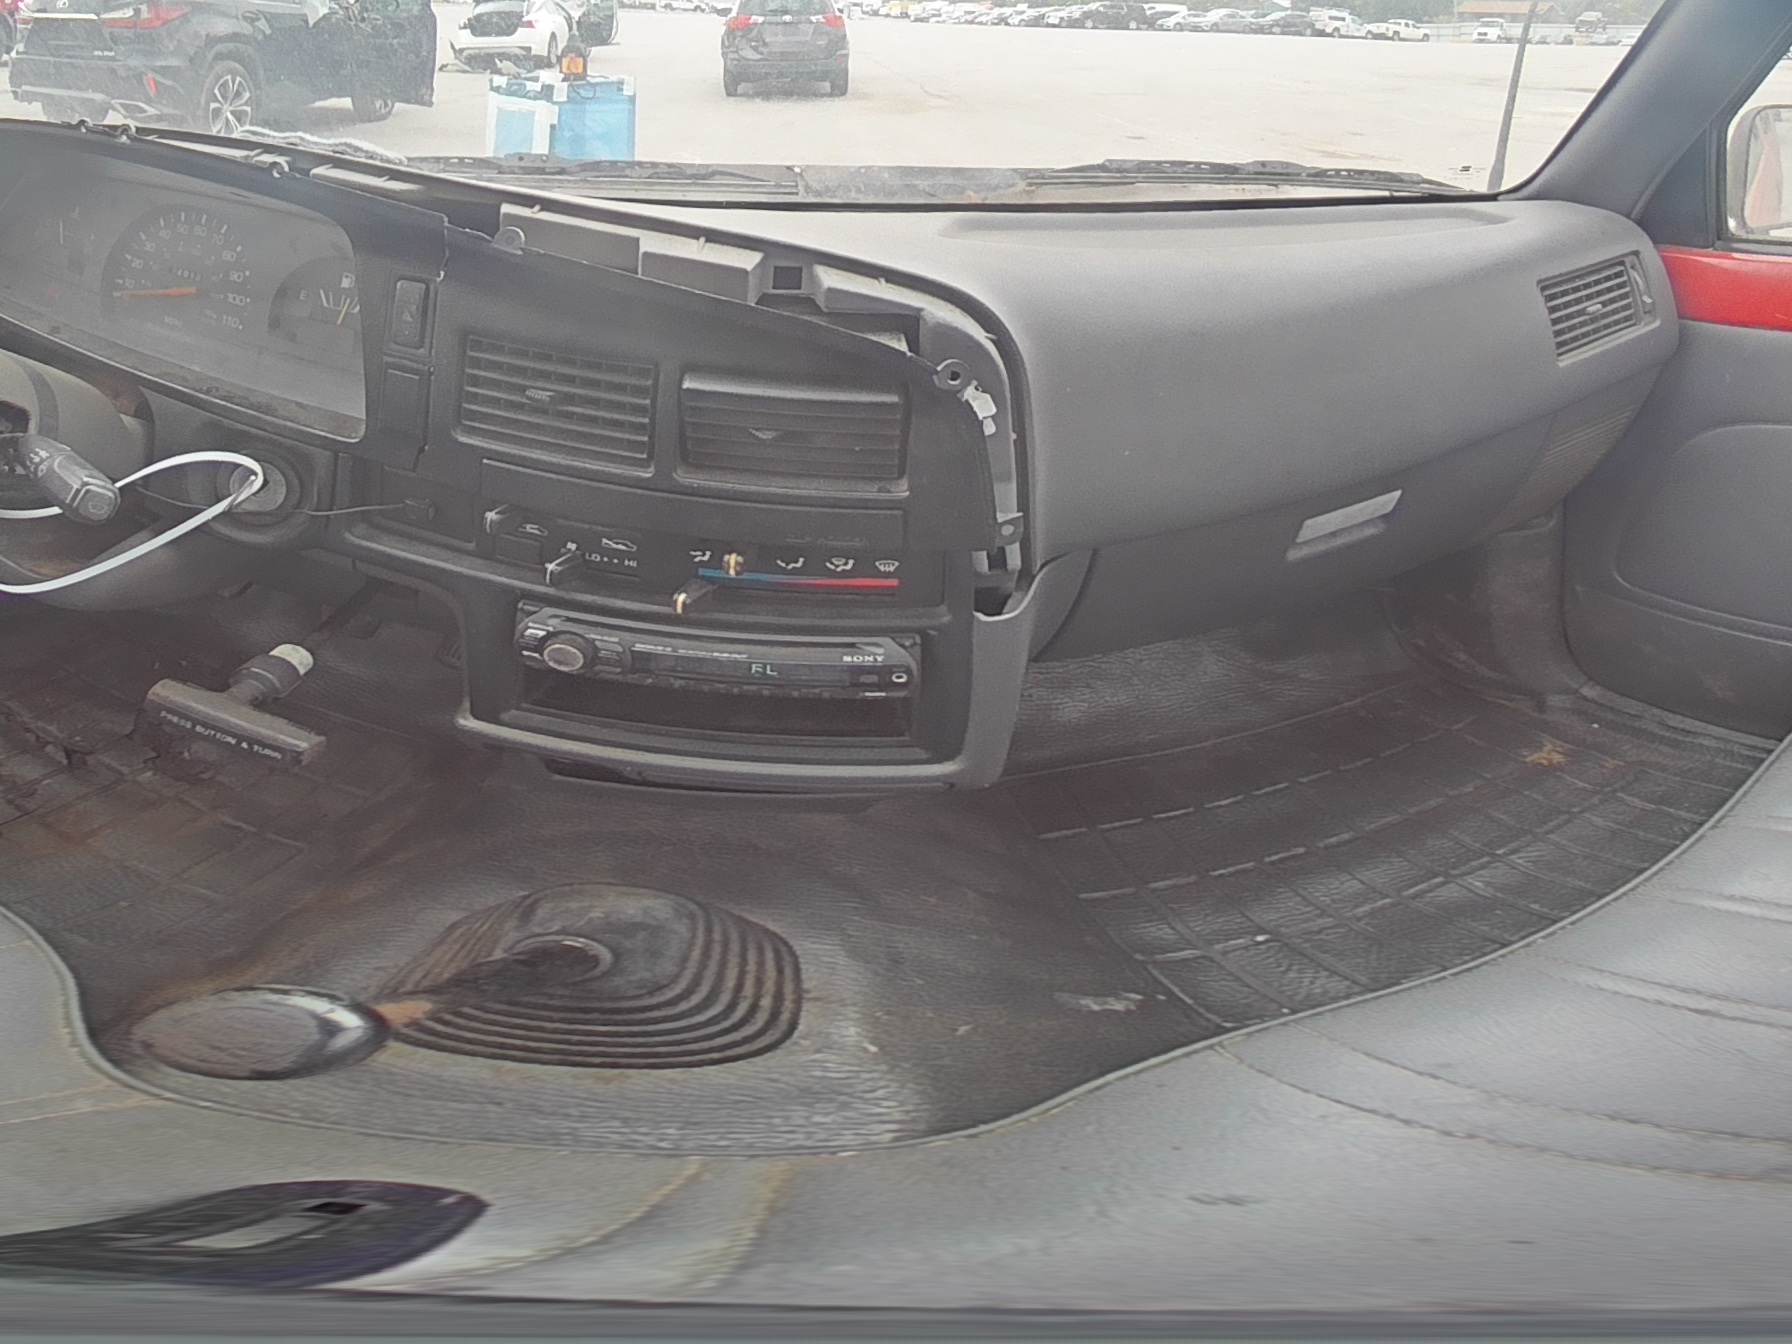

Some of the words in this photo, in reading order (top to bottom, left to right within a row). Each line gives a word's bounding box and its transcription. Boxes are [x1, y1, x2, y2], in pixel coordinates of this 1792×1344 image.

[226, 293, 246, 306] 100
[299, 290, 308, 301] E
[222, 314, 240, 328] 110
[160, 710, 192, 729] PRESS
[195, 724, 237, 745] BUTTON
[252, 744, 282, 760] TURN
